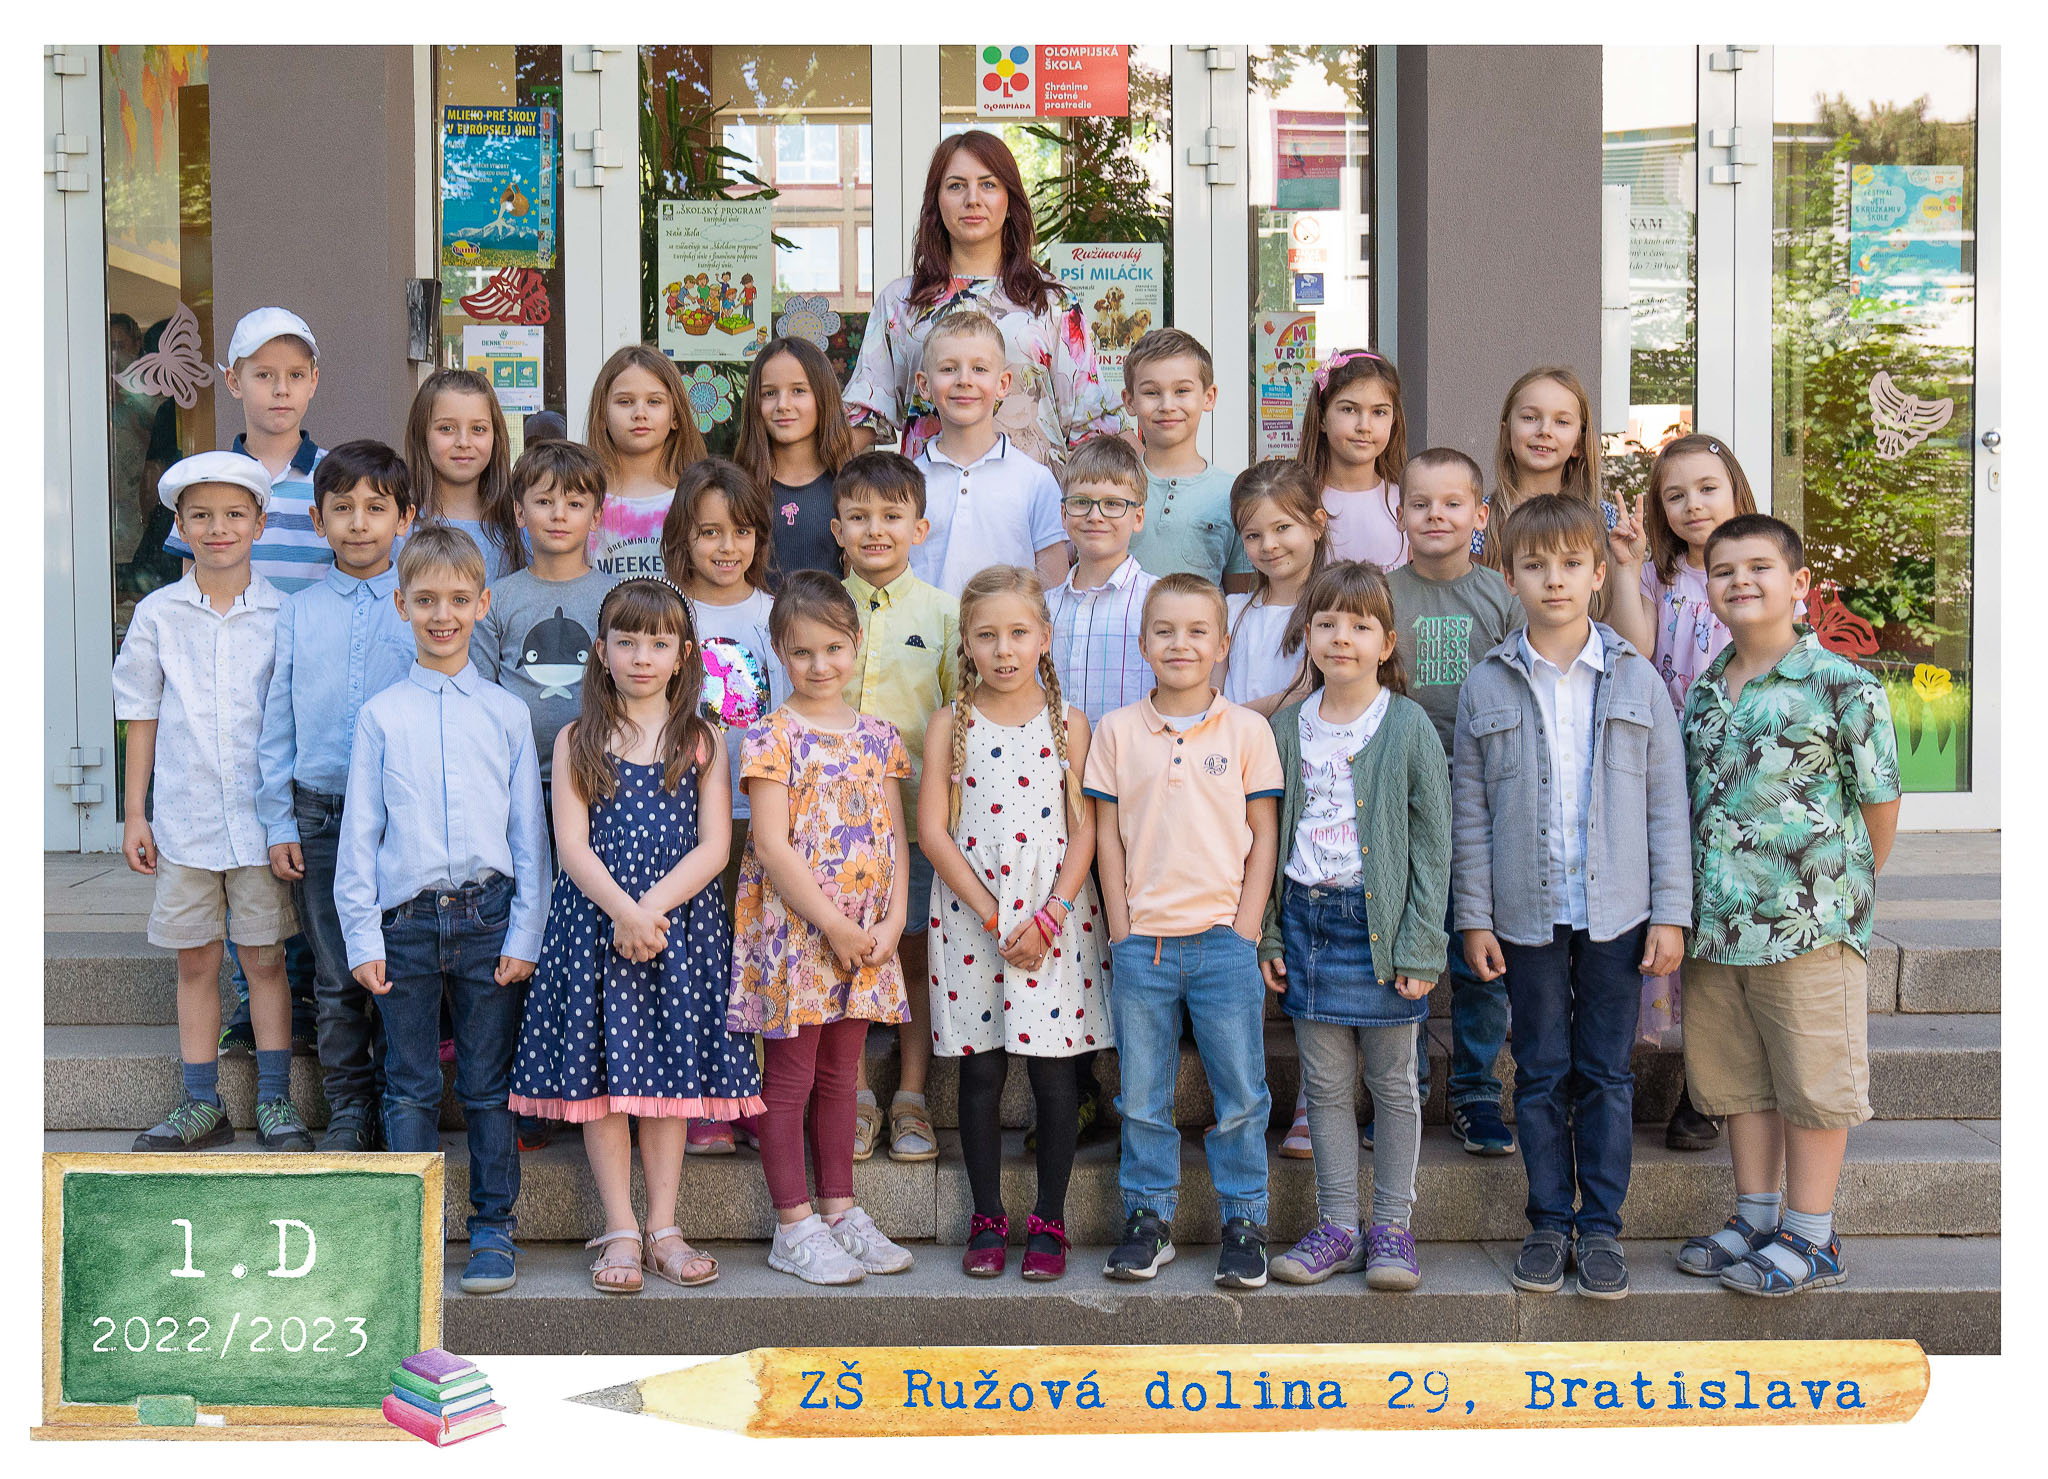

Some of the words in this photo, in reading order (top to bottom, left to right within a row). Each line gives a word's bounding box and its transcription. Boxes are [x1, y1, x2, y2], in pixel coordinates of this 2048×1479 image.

[1044, 45, 1119, 57] OLOMPIJSKÁ
[1044, 58, 1083, 70] ŠKOLA
[1044, 82, 1089, 91] Chránime
[1044, 90, 1078, 100] životné
[1044, 100, 1092, 110] prostredie
[447, 109, 483, 121] MLIEKO
[486, 110, 505, 121] PRE
[507, 109, 537, 122] ŠKOLY
[447, 123, 454, 134] V
[457, 123, 511, 136] EURÓPSKEJ
[514, 124, 536, 136] ÚNII
[683, 227, 700, 237] škola
[1071, 247, 1142, 263] Ružinovský
[1060, 264, 1085, 280] PSÍ
[1090, 263, 1154, 281] MILÁČIK
[1274, 347, 1283, 360] V
[597, 555, 666, 575] WEEKE
[1418, 618, 1468, 640] GUESS
[1418, 639, 1467, 661] GUESS
[1417, 660, 1467, 684] GUESS
